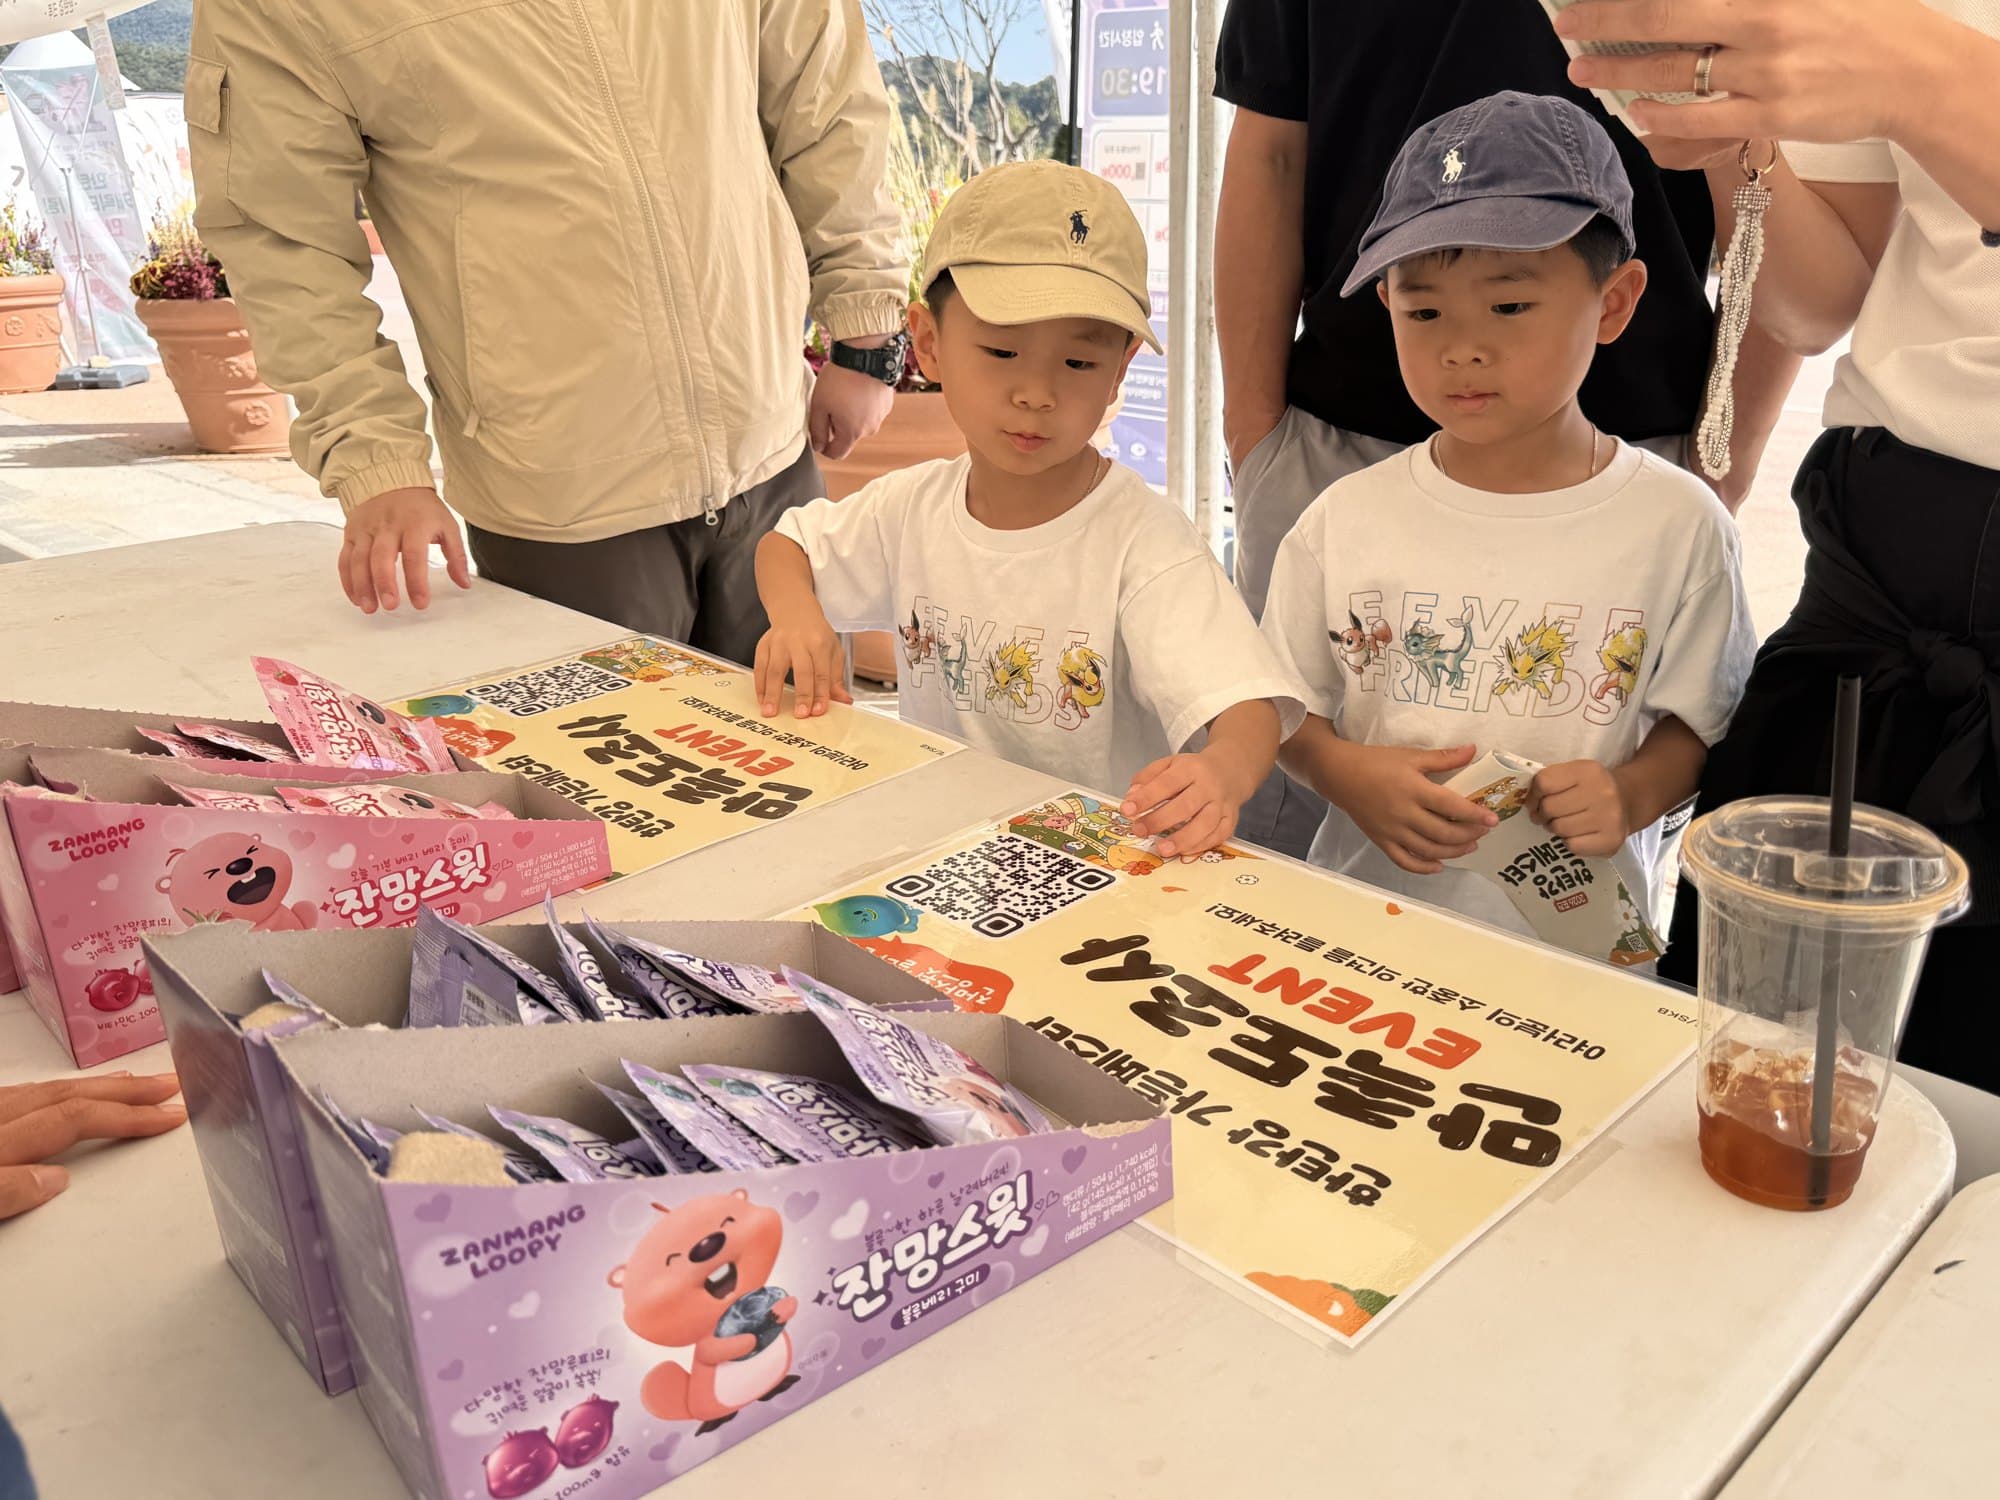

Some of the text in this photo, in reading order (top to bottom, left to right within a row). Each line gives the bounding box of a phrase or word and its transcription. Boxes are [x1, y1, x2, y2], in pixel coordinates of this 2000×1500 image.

[300, 681, 364, 756] 잔망스윗
[736, 718, 774, 738] 의견을
[653, 723, 795, 777] EVENT
[773, 732, 817, 753] 소중한
[810, 745, 870, 771] 여러분의
[557, 713, 813, 820] 만족도조사
[48, 817, 146, 853] ZANMANG
[592, 800, 676, 839] 한탄강
[69, 836, 131, 862] LOOPY
[334, 841, 492, 929] 잔망스윗
[351, 867, 368, 882] 오늘
[1532, 858, 1594, 900] 한탄강
[71, 917, 171, 952] 다양한 잔망루피의
[85, 943, 116, 961] 귀여운
[1205, 902, 1607, 1061] 여러분의 소중한 의견을 들려주세요!
[96, 1013, 138, 1031] 비타민C
[1207, 953, 1482, 1070] EVENT
[1060, 934, 1562, 1168] 만족도조사
[1091, 1175, 1106, 1190] 504
[1139, 1142, 1158, 1158] kcal)
[1227, 1119, 1392, 1207] 한탄강
[918, 1198, 944, 1221] 하루
[439, 1203, 586, 1267] ZANMANG
[469, 1232, 562, 1279] LOOPY
[832, 1169, 1033, 1323] 잔망스윗
[901, 1271, 981, 1327] 블루베리 구미
[463, 1348, 611, 1414] 다양한 잔망루피의
[485, 1393, 529, 1425] 귀여운
[532, 1379, 570, 1404] 얼굴이
[604, 1445, 631, 1467] 함유
